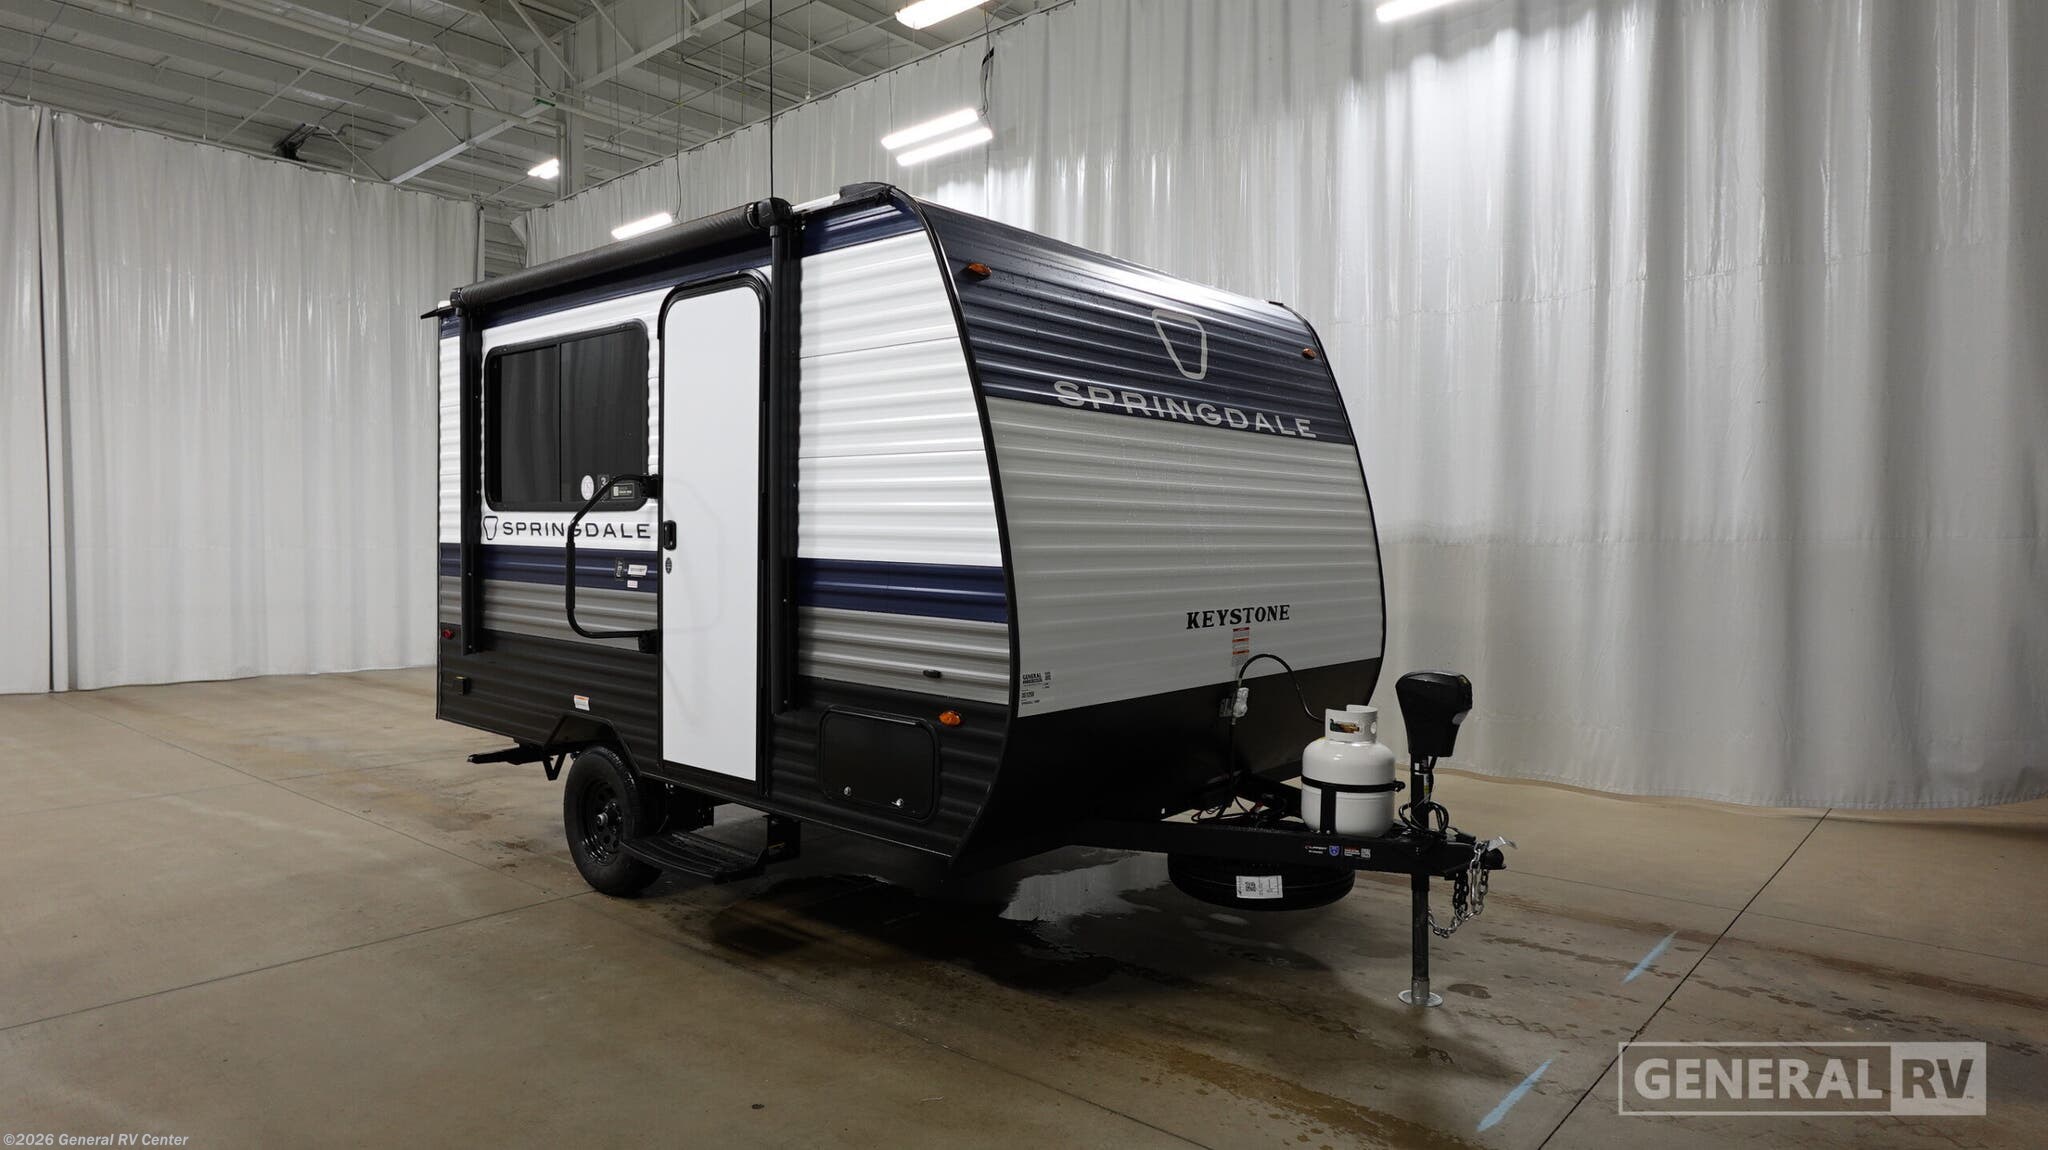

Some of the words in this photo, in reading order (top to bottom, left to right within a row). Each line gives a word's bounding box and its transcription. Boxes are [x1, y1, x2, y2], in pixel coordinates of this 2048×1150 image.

[1053, 380, 1317, 438] SPRINGDALE
[502, 521, 651, 539] SPRINGDALE
[1186, 604, 1290, 630] KEYSTONE
